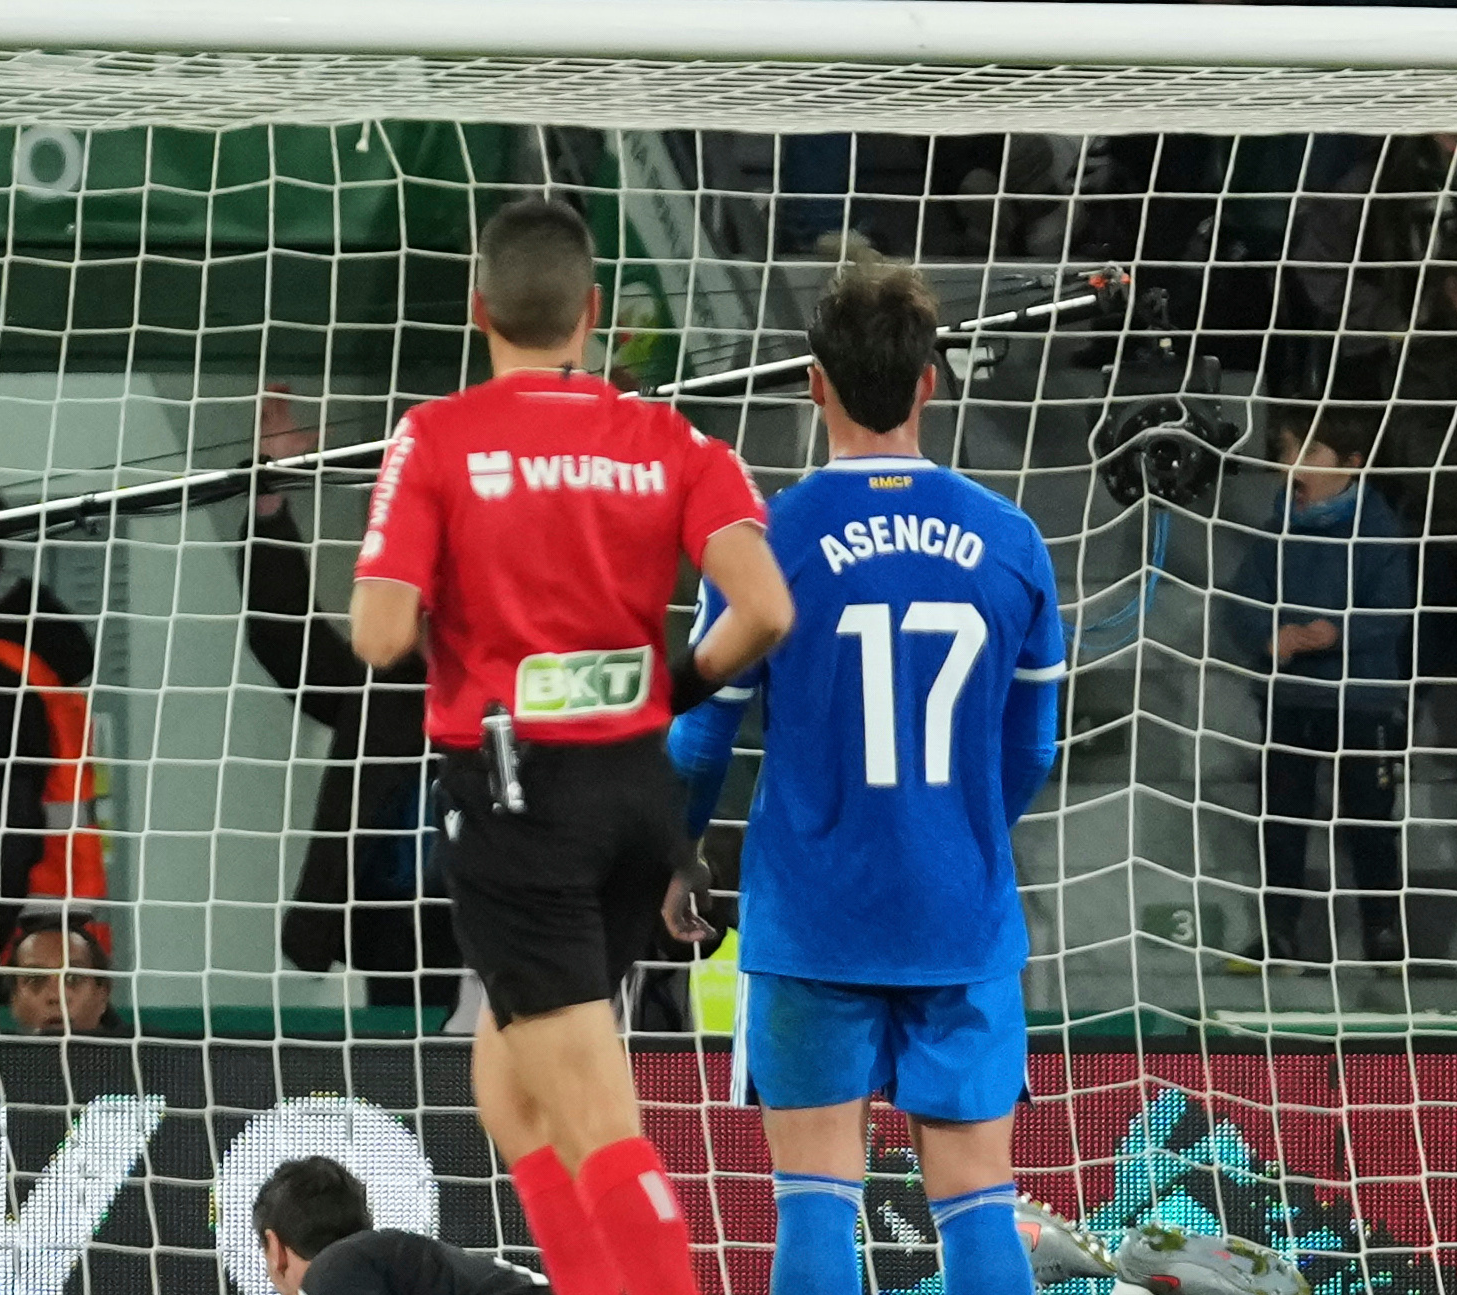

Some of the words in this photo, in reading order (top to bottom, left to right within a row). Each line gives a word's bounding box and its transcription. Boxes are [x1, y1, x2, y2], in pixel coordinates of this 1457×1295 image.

[518, 454, 667, 497] WÜRTH
[868, 475, 914, 489] RMCF
[818, 515, 984, 576] ASENCIO
[524, 660, 642, 705] BKT
[836, 601, 988, 787] 17
[1170, 909, 1195, 942] 3
